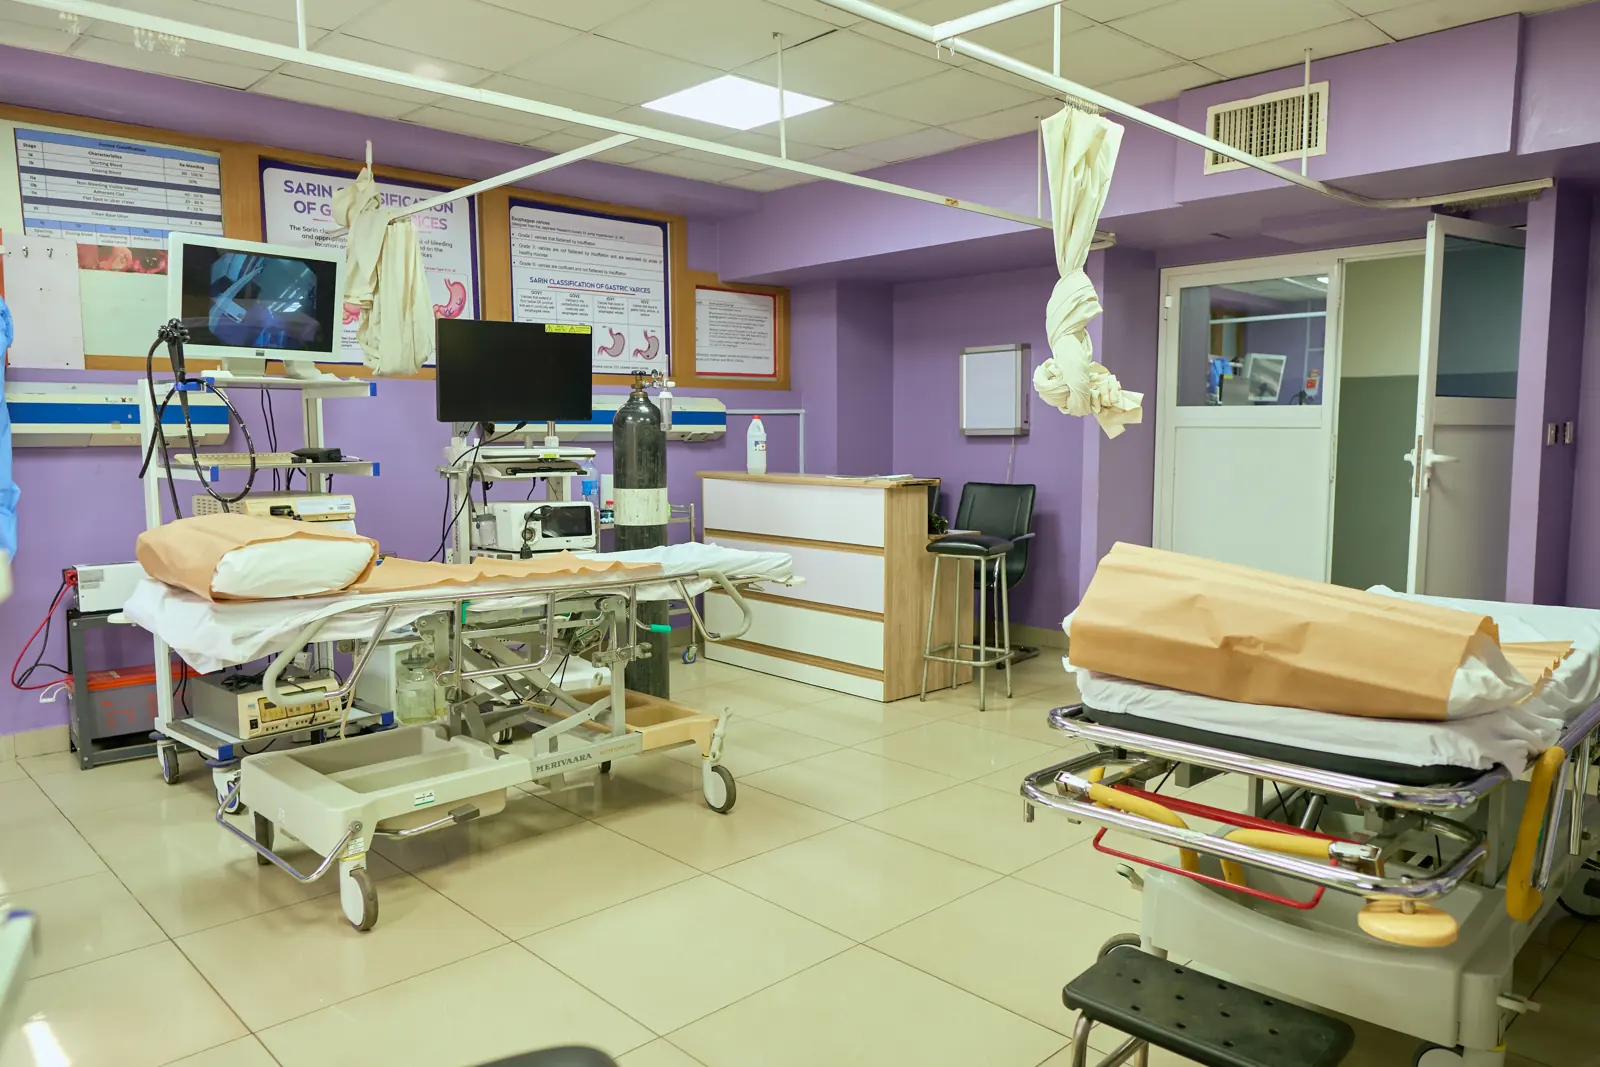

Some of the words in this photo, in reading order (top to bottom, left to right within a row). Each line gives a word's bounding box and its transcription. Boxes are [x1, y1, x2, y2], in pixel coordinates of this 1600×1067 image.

[88, 150, 122, 159] Characteristics
[284, 180, 333, 198] SARIN
[294, 200, 317, 215] OF
[314, 241, 338, 249] location
[430, 240, 453, 248] bleeding
[530, 276, 548, 284] SARIN
[549, 279, 596, 288] CLASSIFICATION
[605, 284, 629, 292] GASTRIC
[629, 286, 651, 294] VARICES
[536, 753, 592, 773] MERIVAARA
